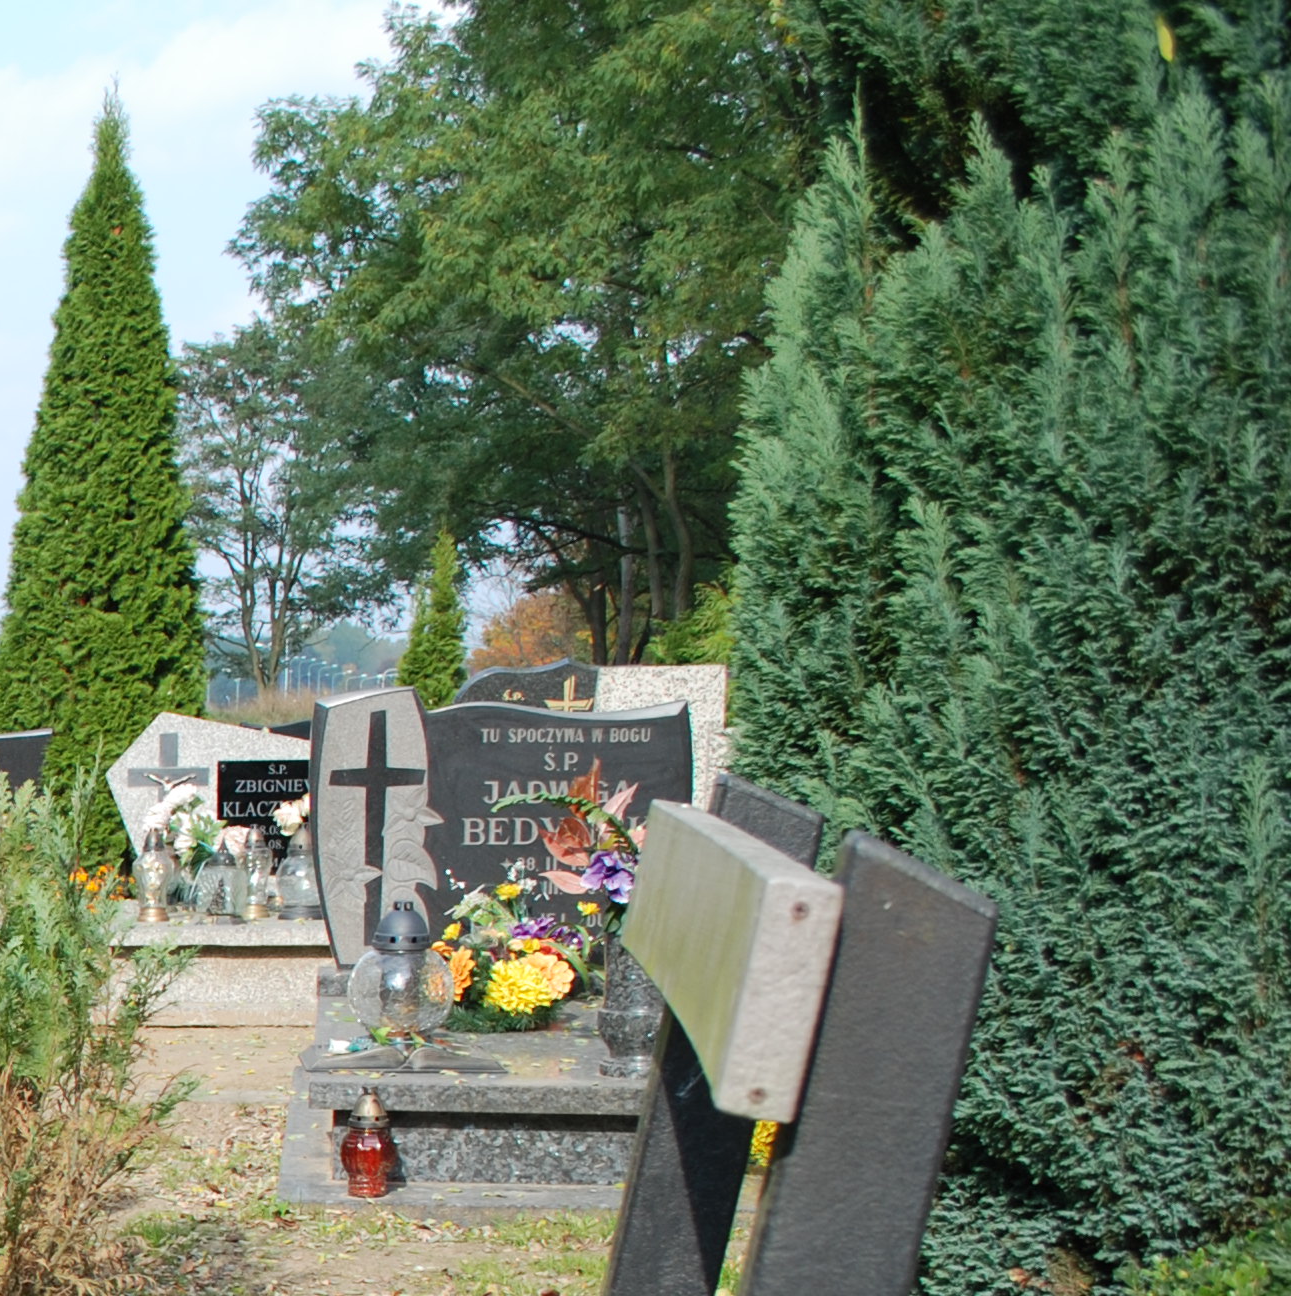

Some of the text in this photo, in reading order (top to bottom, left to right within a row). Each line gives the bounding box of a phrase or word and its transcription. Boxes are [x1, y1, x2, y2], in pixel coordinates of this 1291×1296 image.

[481, 727, 651, 743] TU SPOCZYWA W BOGU
[544, 746, 579, 771] Ś.P.
